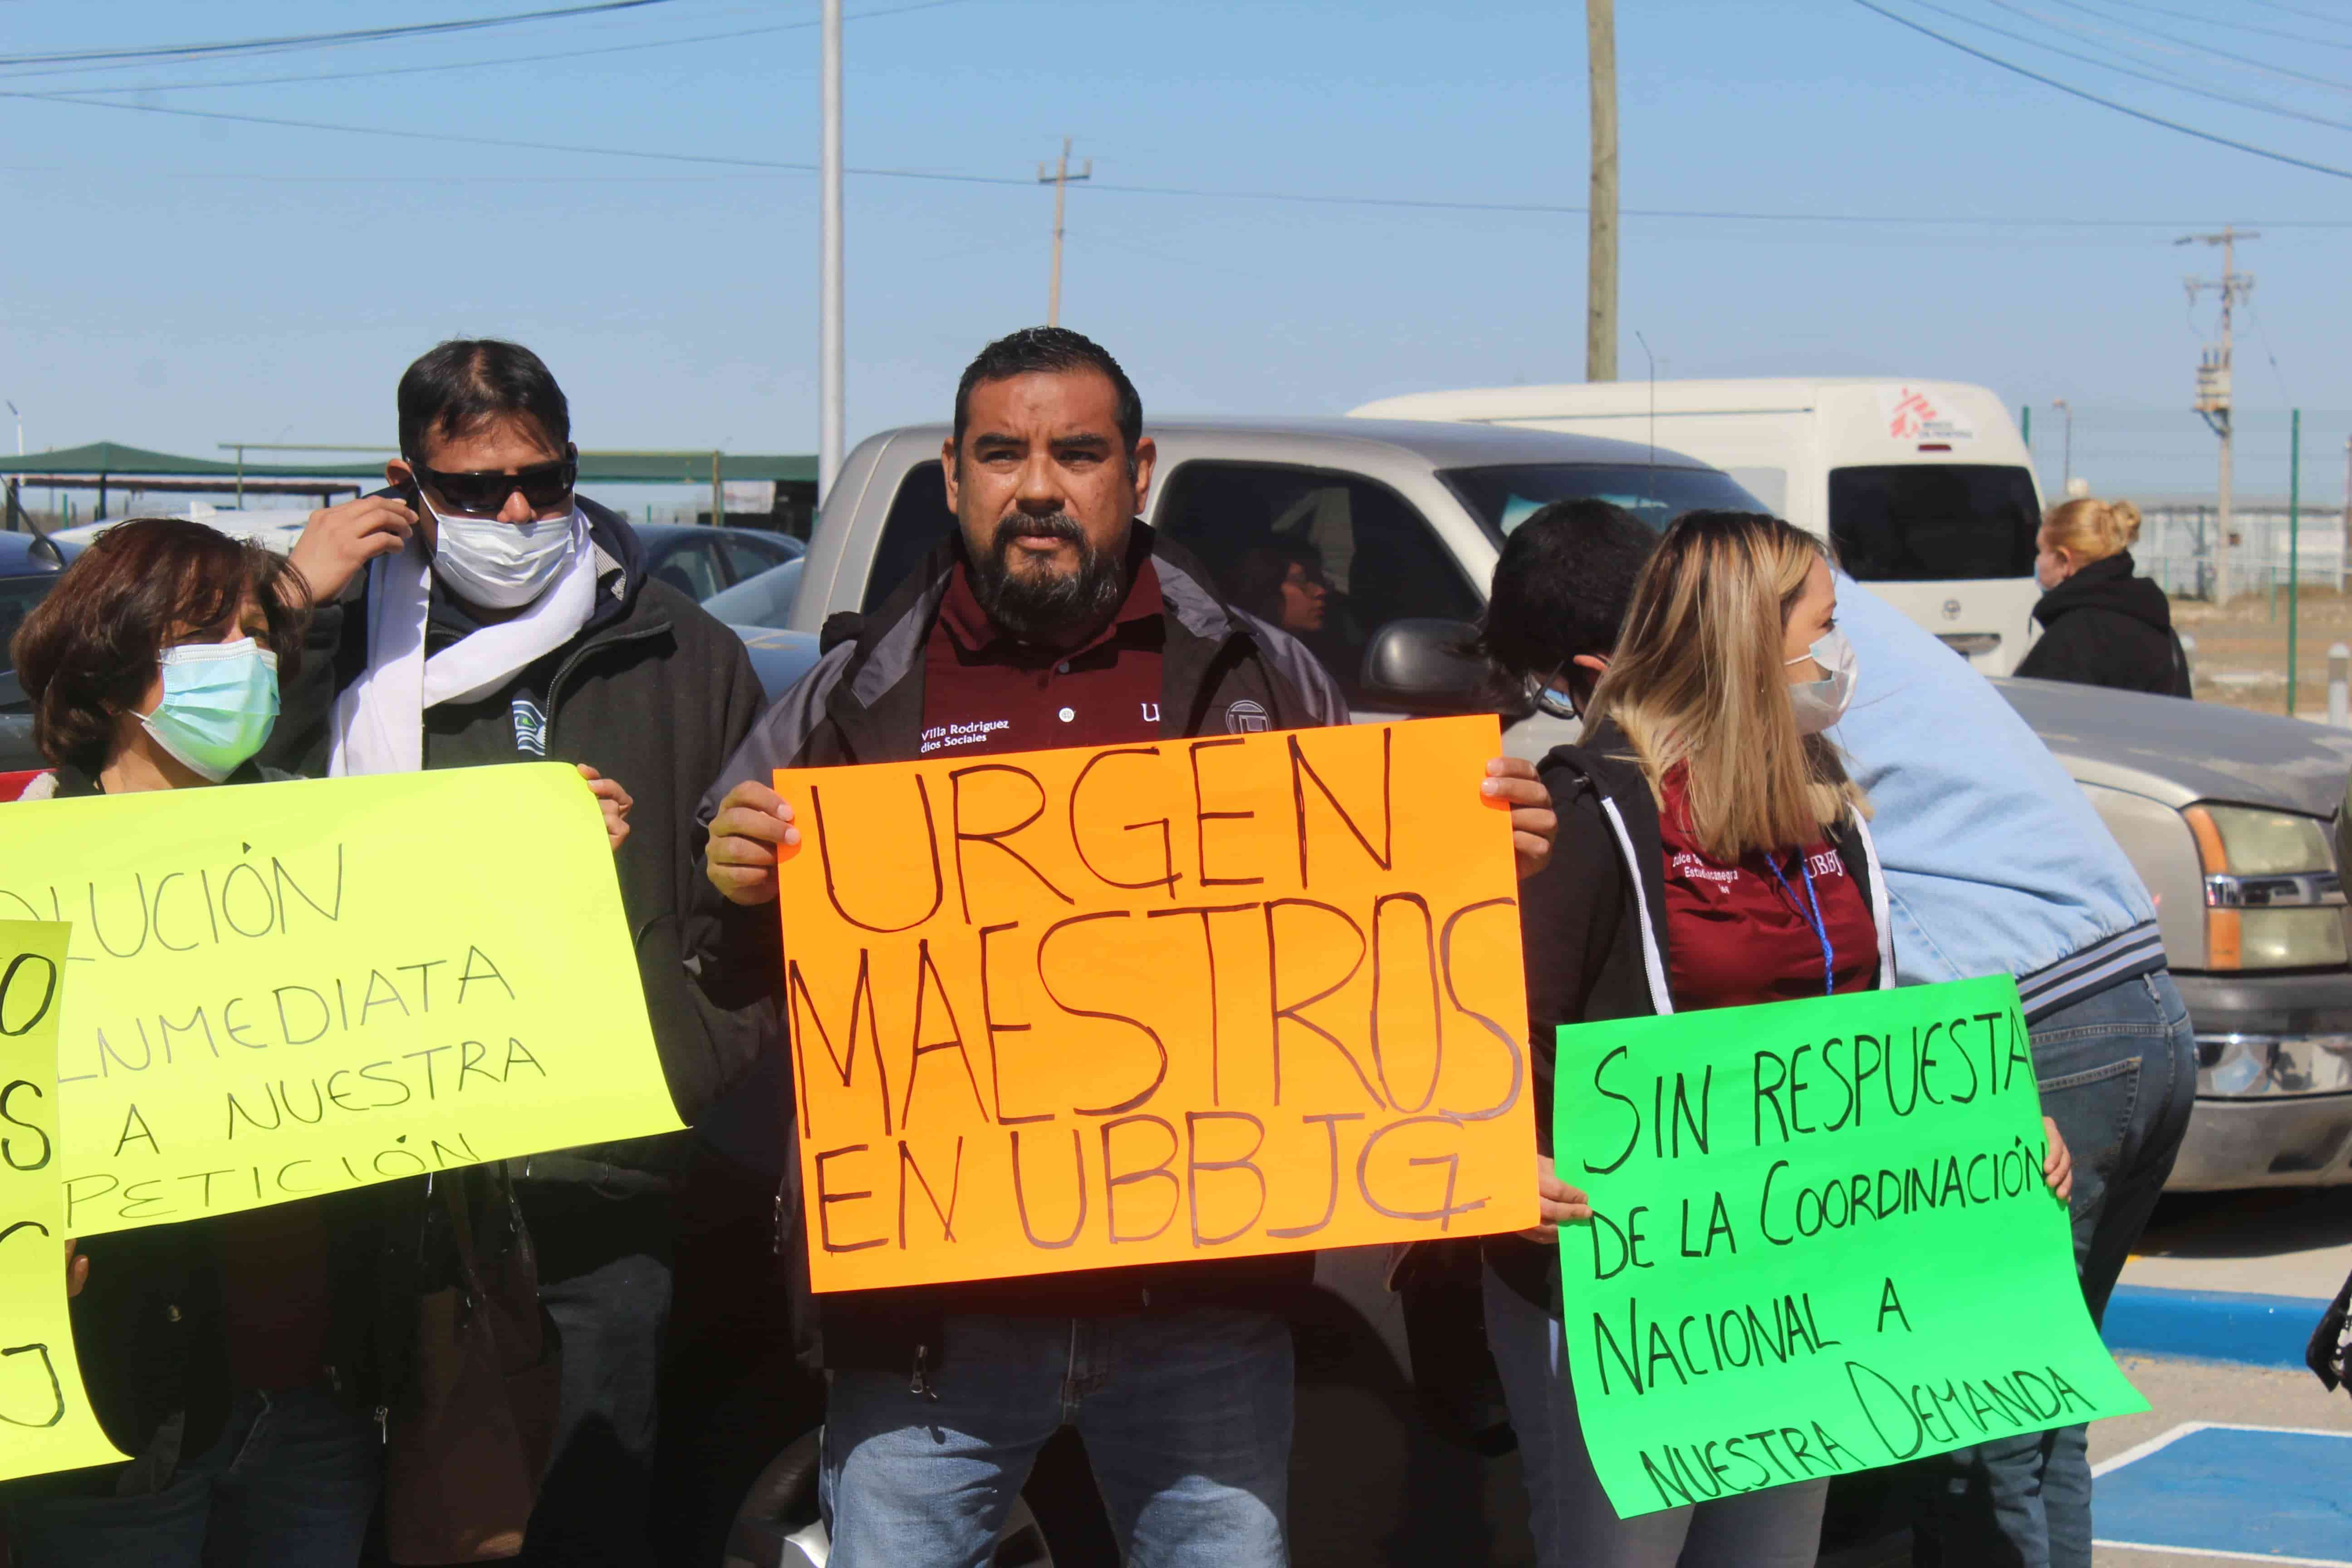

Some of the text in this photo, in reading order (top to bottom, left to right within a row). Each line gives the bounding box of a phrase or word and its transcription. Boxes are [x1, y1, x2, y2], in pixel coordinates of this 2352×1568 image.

[920, 733, 987, 753] dios Sociales
[921, 720, 1009, 740] Villa Rodriguez
[811, 727, 1391, 933] URGEN
[58, 945, 515, 1083] NMEDIATA
[788, 892, 1524, 1137] MAESTROS
[113, 1036, 547, 1157] A NUESTRA
[1583, 1006, 2035, 1175] SIN RESPUESTA
[61, 1133, 482, 1229] PETICIÓN
[816, 1112, 1492, 1255] EN UBBJG
[1589, 1135, 2049, 1280] DE LA COORDINACIÓN
[1593, 1277, 1912, 1396] NACIONAL A
[1639, 1361, 2098, 1509] NUESTRA DEMANDA
